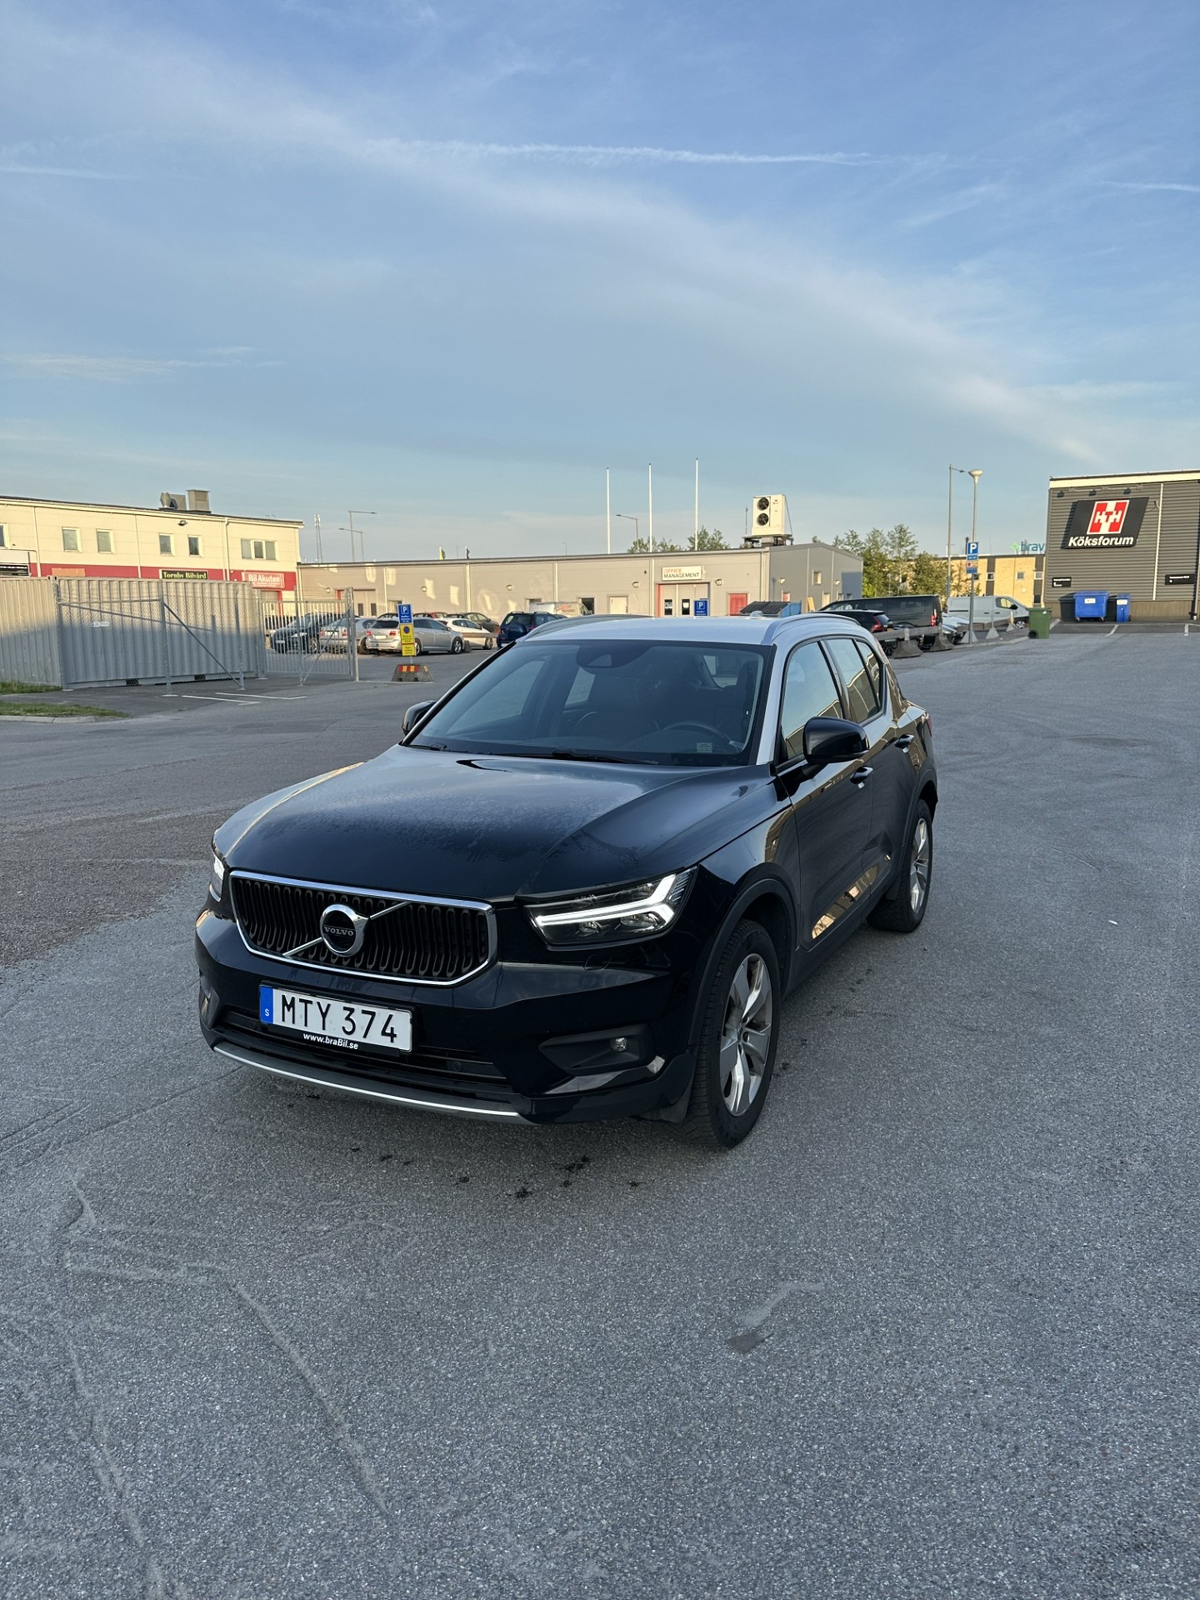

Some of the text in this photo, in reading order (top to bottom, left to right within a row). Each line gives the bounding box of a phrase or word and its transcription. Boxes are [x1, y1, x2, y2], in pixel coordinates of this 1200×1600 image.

[1068, 535, 1134, 547] Köksforum
[969, 543, 977, 554] P
[248, 574, 280, 583] Bil Akuten
[323, 926, 355, 937] VOLVO
[264, 1008, 270, 1017] S
[281, 993, 398, 1044] MTY 374
[303, 1032, 359, 1051] www.braBil.se
